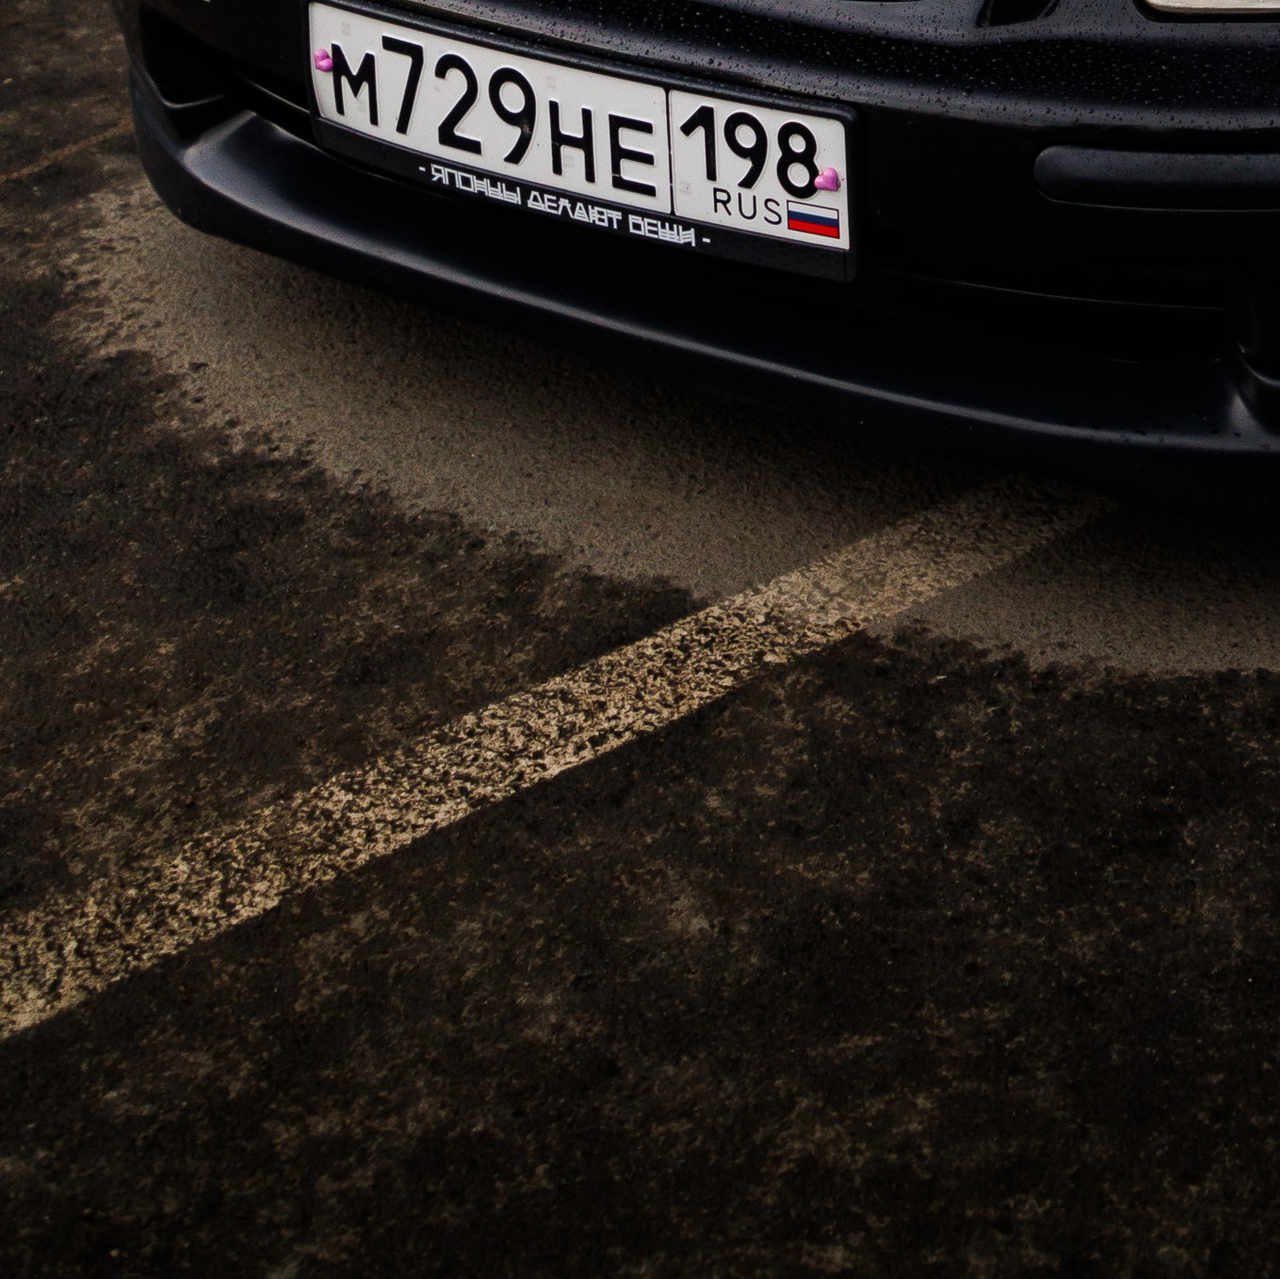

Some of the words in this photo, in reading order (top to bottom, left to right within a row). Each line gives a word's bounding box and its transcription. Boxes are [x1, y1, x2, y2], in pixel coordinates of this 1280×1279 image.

[330, 34, 658, 198] М729НЕ
[679, 104, 820, 199] 198
[712, 187, 783, 226] RUS
